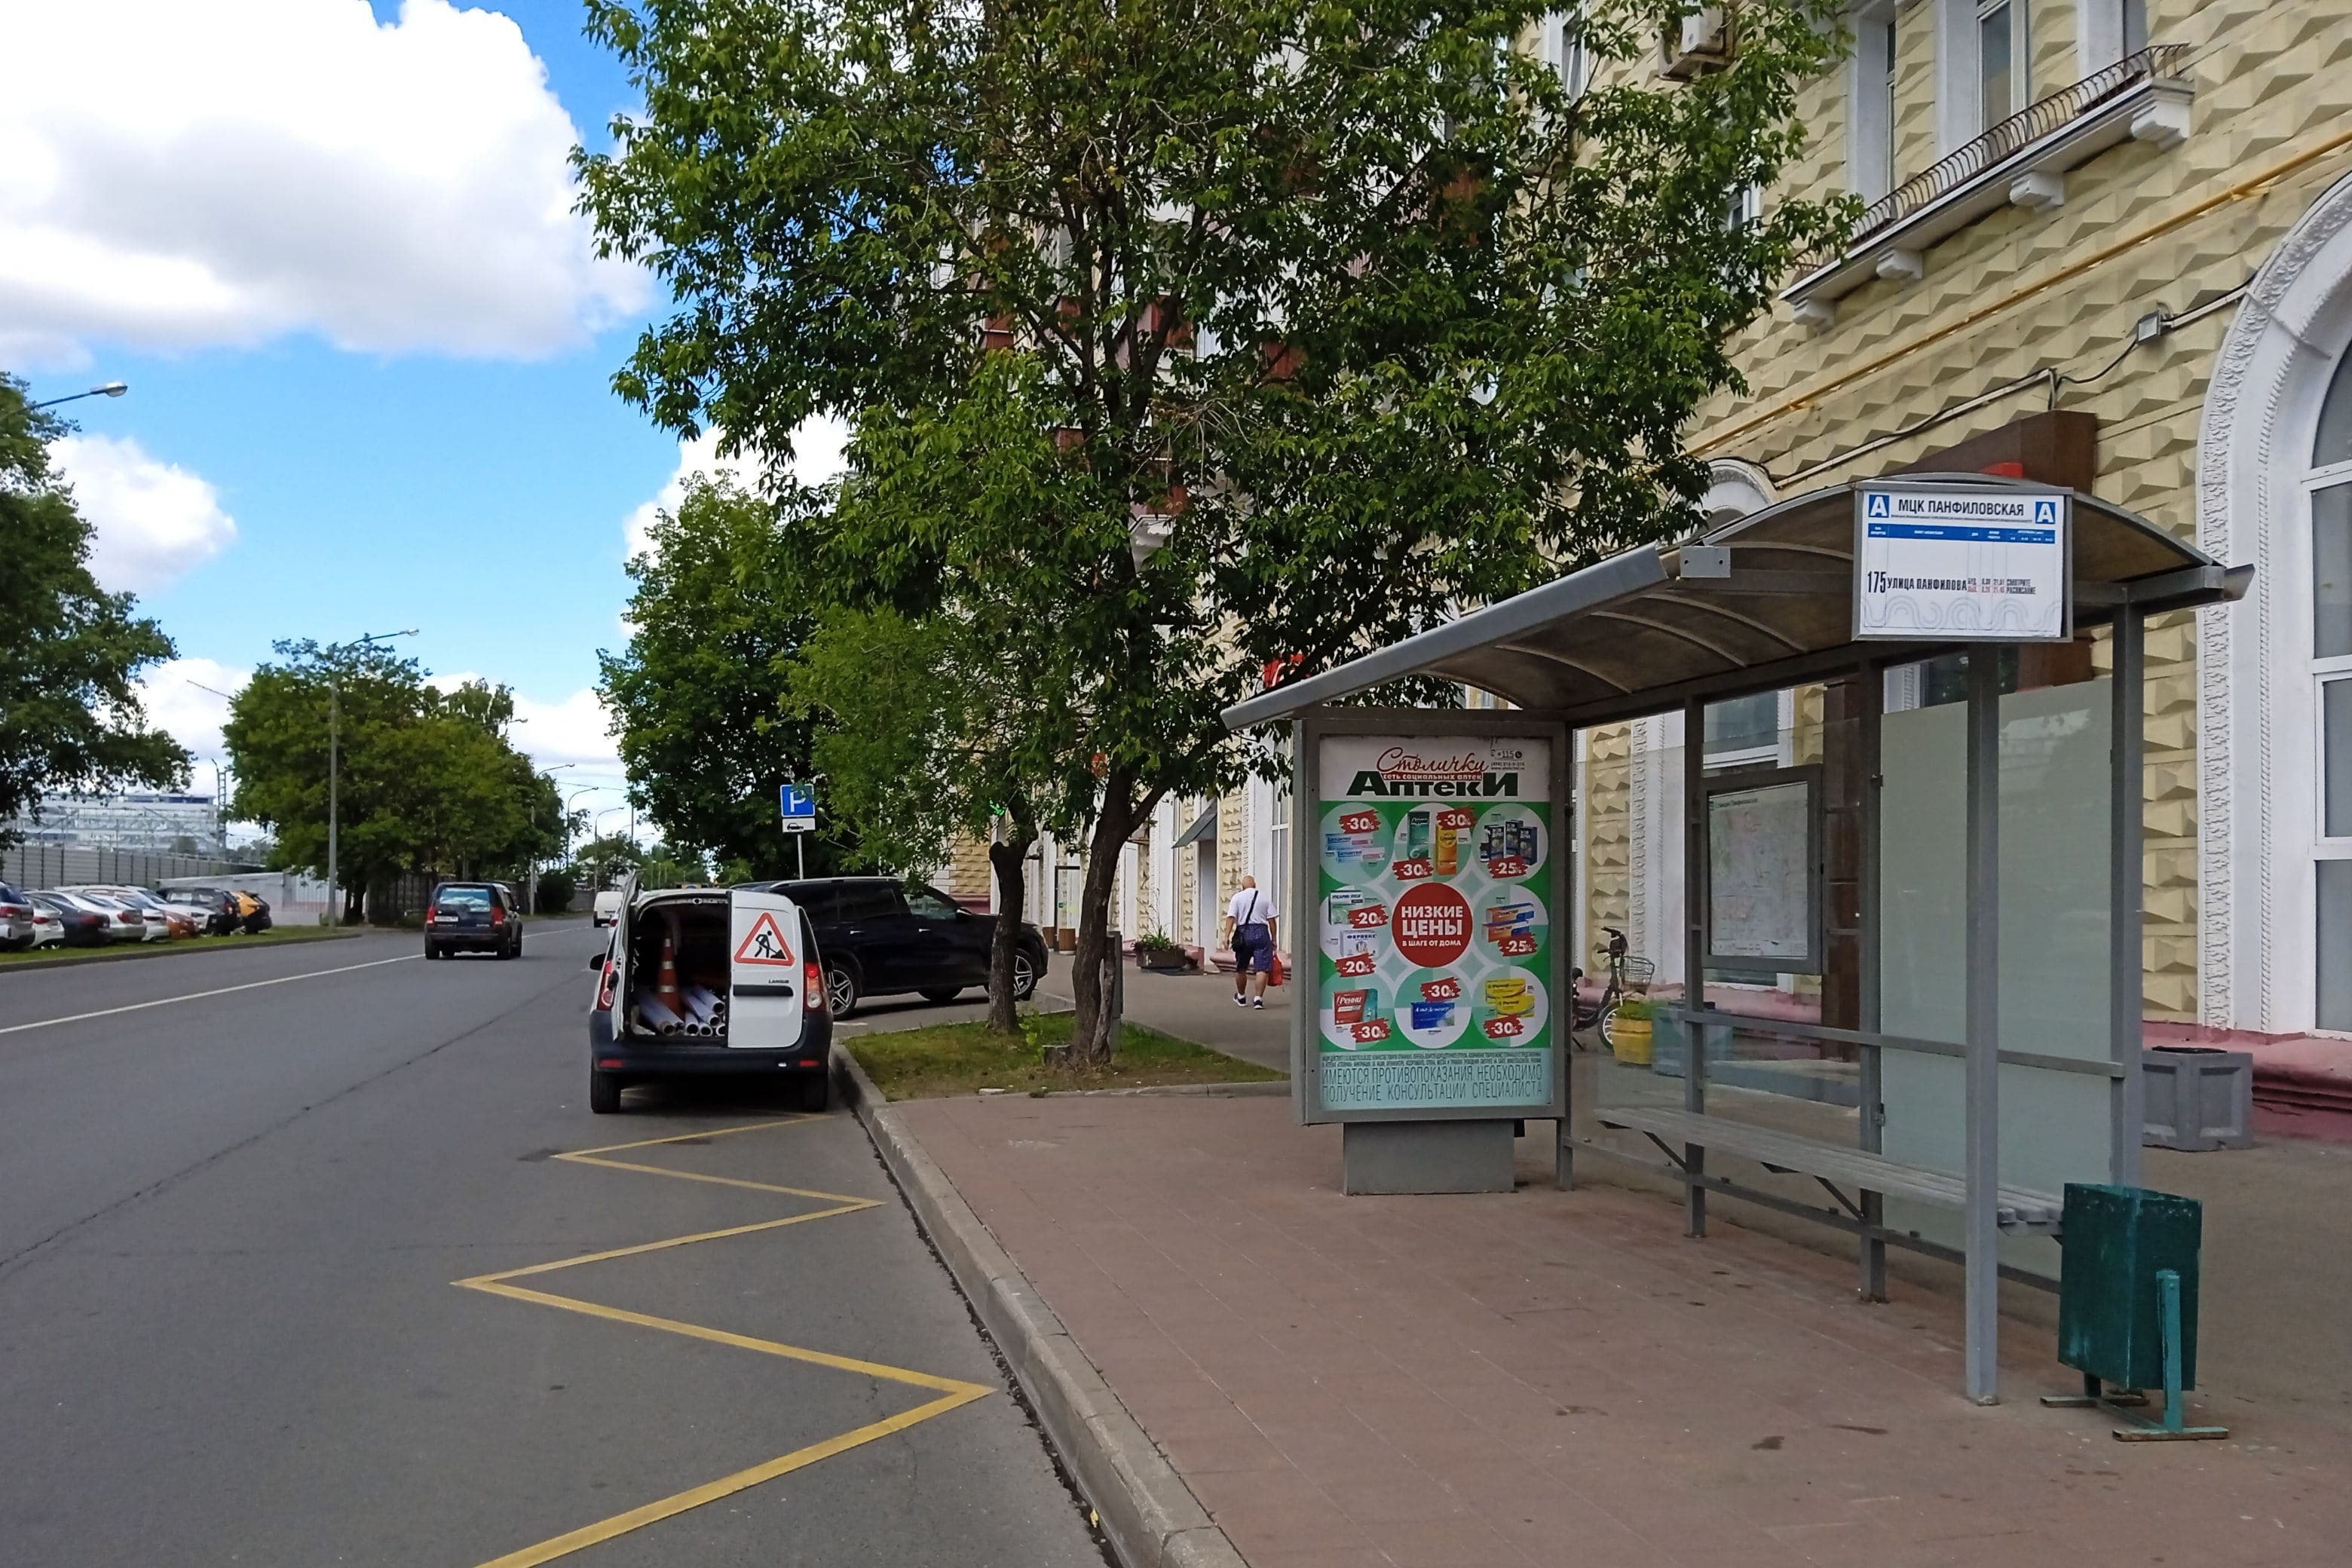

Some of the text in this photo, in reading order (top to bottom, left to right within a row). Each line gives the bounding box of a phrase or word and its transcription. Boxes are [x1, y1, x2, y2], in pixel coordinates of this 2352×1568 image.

[1870, 496, 1888, 516] А
[1898, 499, 1925, 513] МЦК
[1928, 501, 2024, 516] ПАНФИЛОВСКАЯ
[2037, 503, 2054, 522] А
[1867, 571, 1967, 593] 175 УЛИЦА ПАНФИЛОВА
[1377, 747, 1490, 773] Столички
[1403, 773, 1455, 781] социальных
[1346, 817, 1375, 830] -30%
[1444, 814, 1472, 826] -30%
[1400, 863, 1428, 876] -30%
[1495, 862, 1522, 874] -25%
[1401, 906, 1463, 917] НИЗКИЕ
[1355, 912, 1383, 924] -20%
[1402, 919, 1462, 939] ЦЕНЫ
[1505, 940, 1533, 952] -25%
[1343, 961, 1370, 973] -20%
[1428, 985, 1455, 997] -30%
[1358, 1026, 1386, 1038] -30%
[1491, 1021, 1518, 1034] -30%
[1322, 1067, 1369, 1085] ИМЕЮТСЯ
[1478, 1064, 1542, 1082] НЕОБХОДИМО
[1322, 1080, 1542, 1102] ПОЛУЧЕНИЕ КОНСУЛЬТАЦИИ СПЕЦИАЛИСТА
